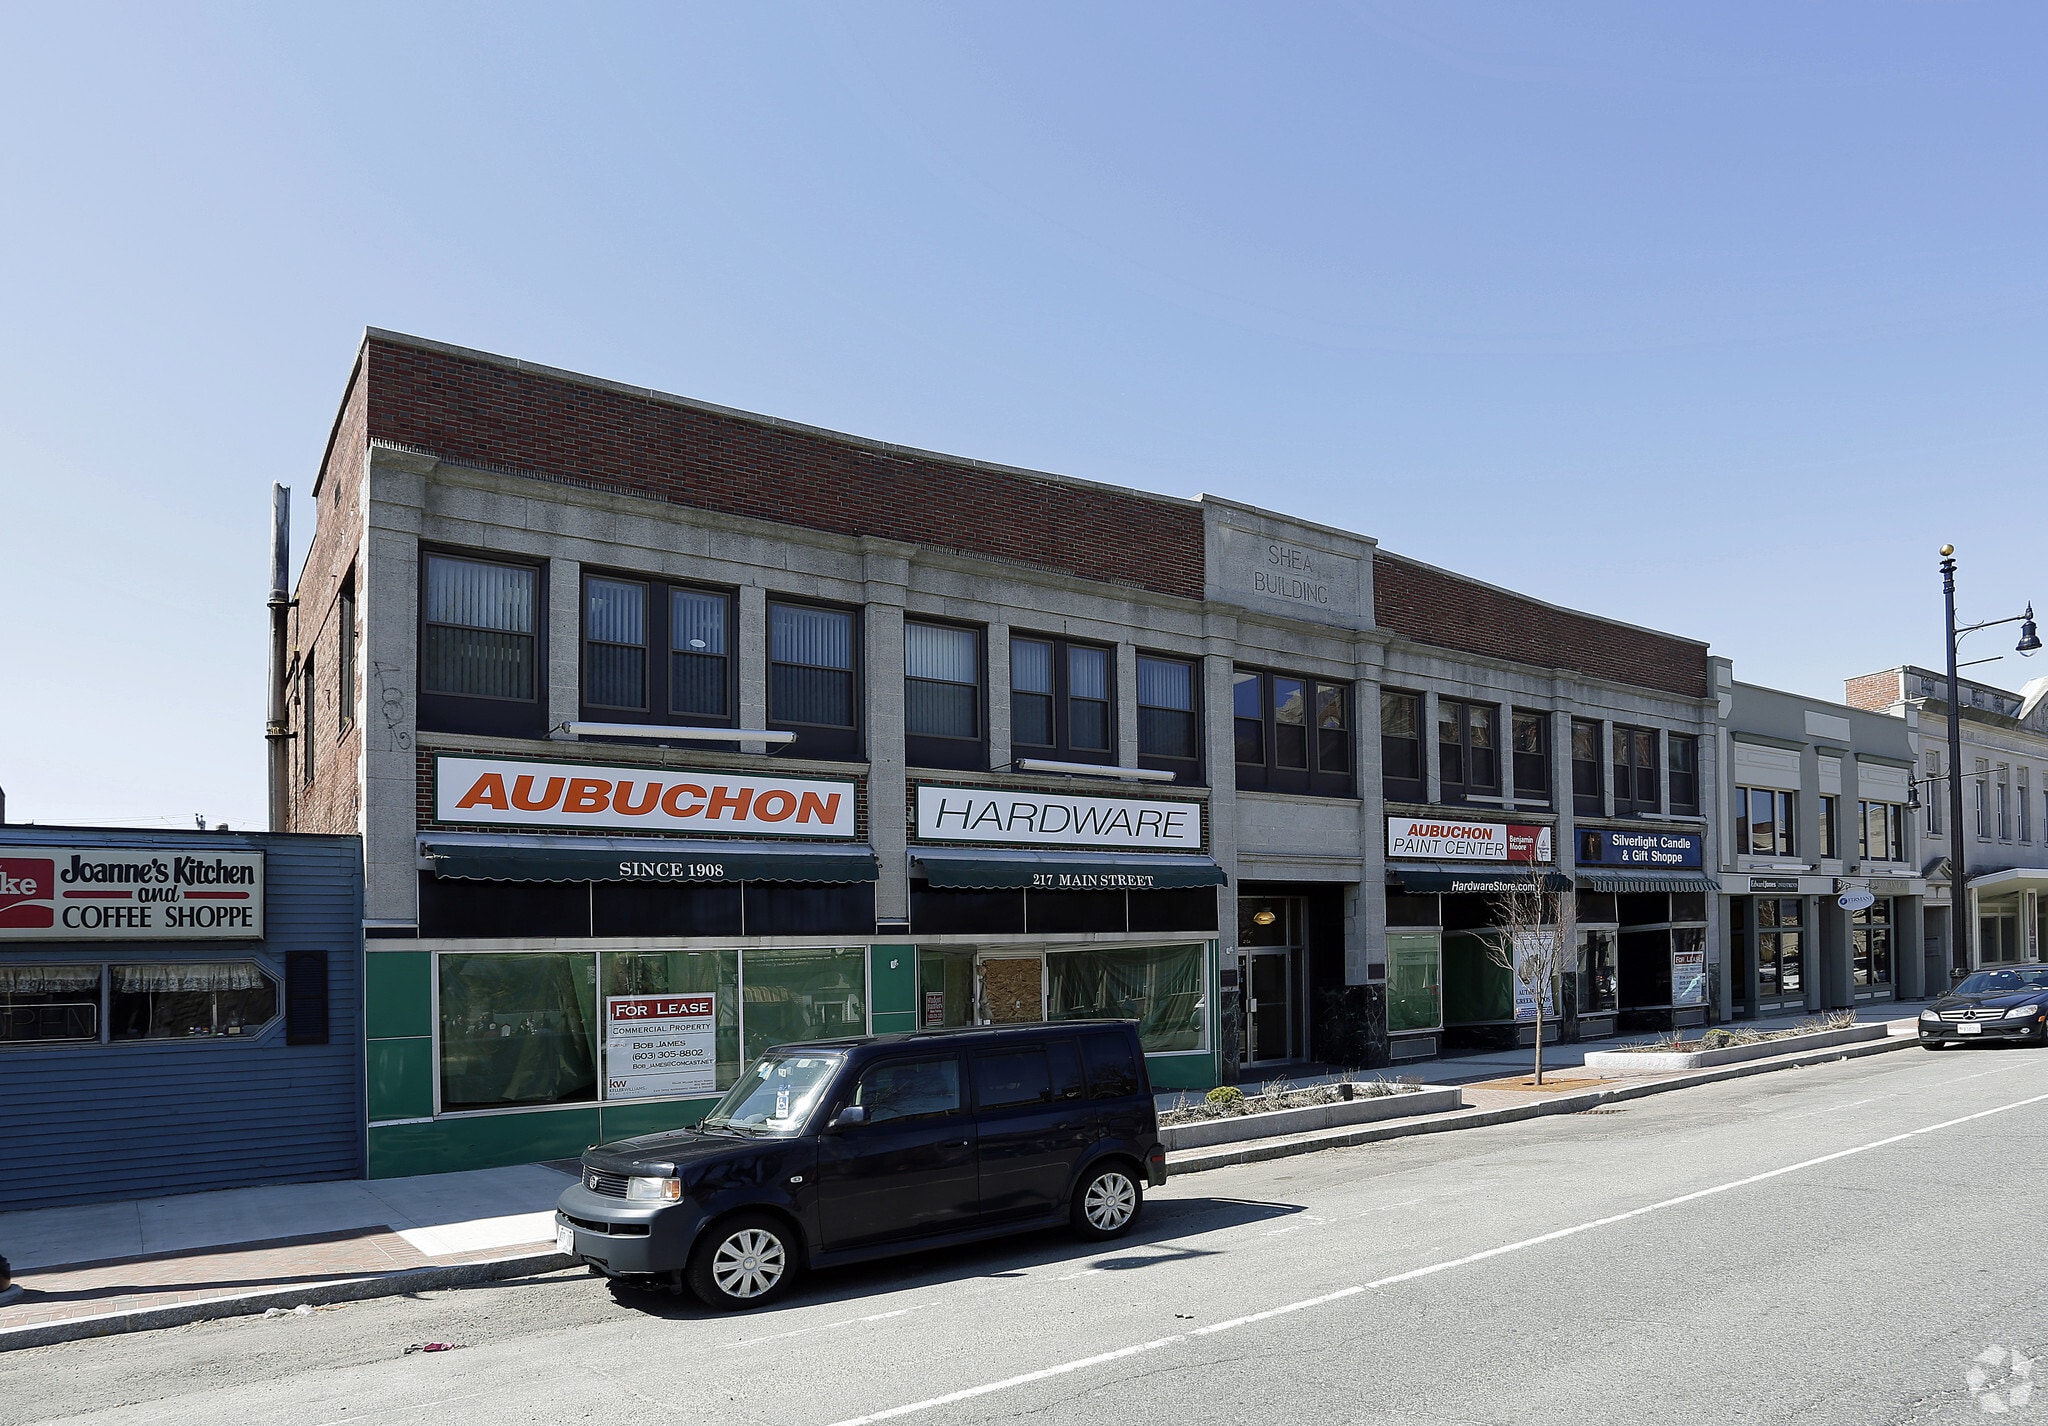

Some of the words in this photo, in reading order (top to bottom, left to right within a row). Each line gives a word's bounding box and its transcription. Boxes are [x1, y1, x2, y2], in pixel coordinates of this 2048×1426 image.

[1268, 545, 1313, 573] SHEA
[1254, 571, 1328, 604] BUILDING
[455, 772, 842, 825] AUBUCHON
[935, 798, 1188, 839] HARDWARE
[1408, 824, 1493, 840] AUBUCHON
[1509, 835, 1533, 844] Benjamin
[1393, 838, 1441, 854] PAINT
[1445, 840, 1504, 856] CENTER
[1509, 843, 1527, 851] Moore
[1612, 834, 1657, 849] Silverlight
[1660, 837, 1691, 849] Candle
[1622, 850, 1629, 861] &
[1632, 850, 1648, 861] Gift
[1651, 851, 1682, 864] Shoppe
[61, 855, 168, 884] Joanne's
[174, 856, 255, 885] Kitchen
[619, 862, 683, 877] SINCE
[688, 862, 724, 877] 1908
[1032, 874, 1053, 886] 217
[1058, 875, 1098, 886] MAIN
[1100, 875, 1154, 887] STREET
[1451, 880, 1536, 892] HardwareStore.com
[138, 885, 180, 903] and
[62, 905, 152, 928] COFFEE
[165, 905, 253, 928] SHOPPE
[616, 1004, 648, 1017] FOR
[657, 1002, 709, 1015] LEASE
[0, 1008, 91, 1038] PEN
[612, 1026, 667, 1035] COMMERCIAL
[669, 1023, 711, 1032] PROPERTY
[656, 1040, 686, 1048] JAMES
[632, 1052, 655, 1062] (603)
[658, 1049, 703, 1059] 305-8802
[609, 1079, 627, 1088] kw
